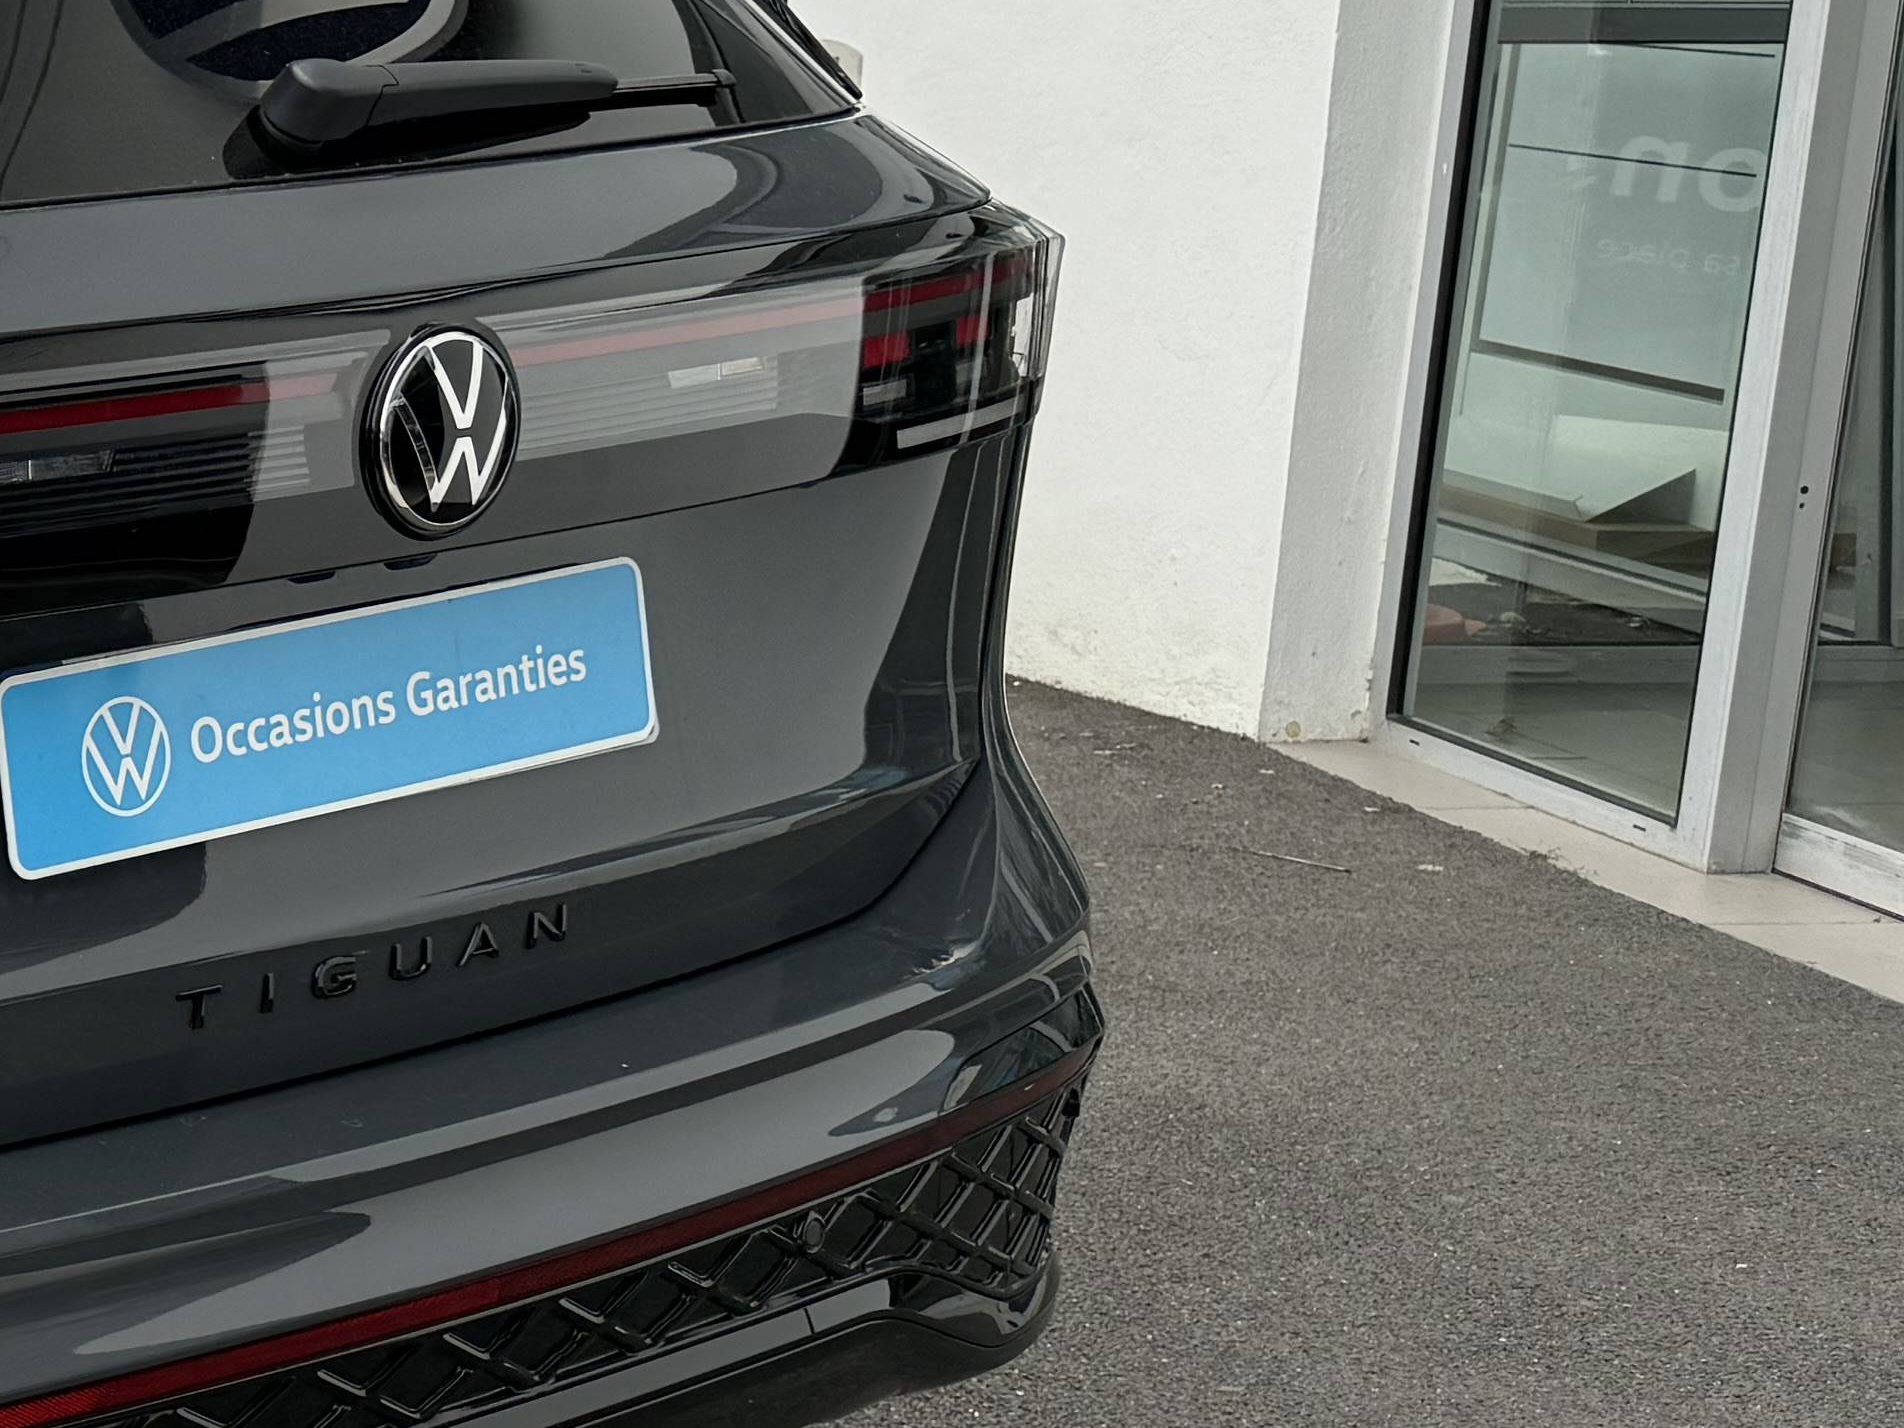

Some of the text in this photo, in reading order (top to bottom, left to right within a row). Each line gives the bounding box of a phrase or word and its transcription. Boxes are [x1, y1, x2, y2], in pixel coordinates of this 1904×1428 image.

[80, 695, 172, 817] VW
[191, 643, 588, 765] Occasions Garanties
[175, 902, 569, 1030] TIGUAN
